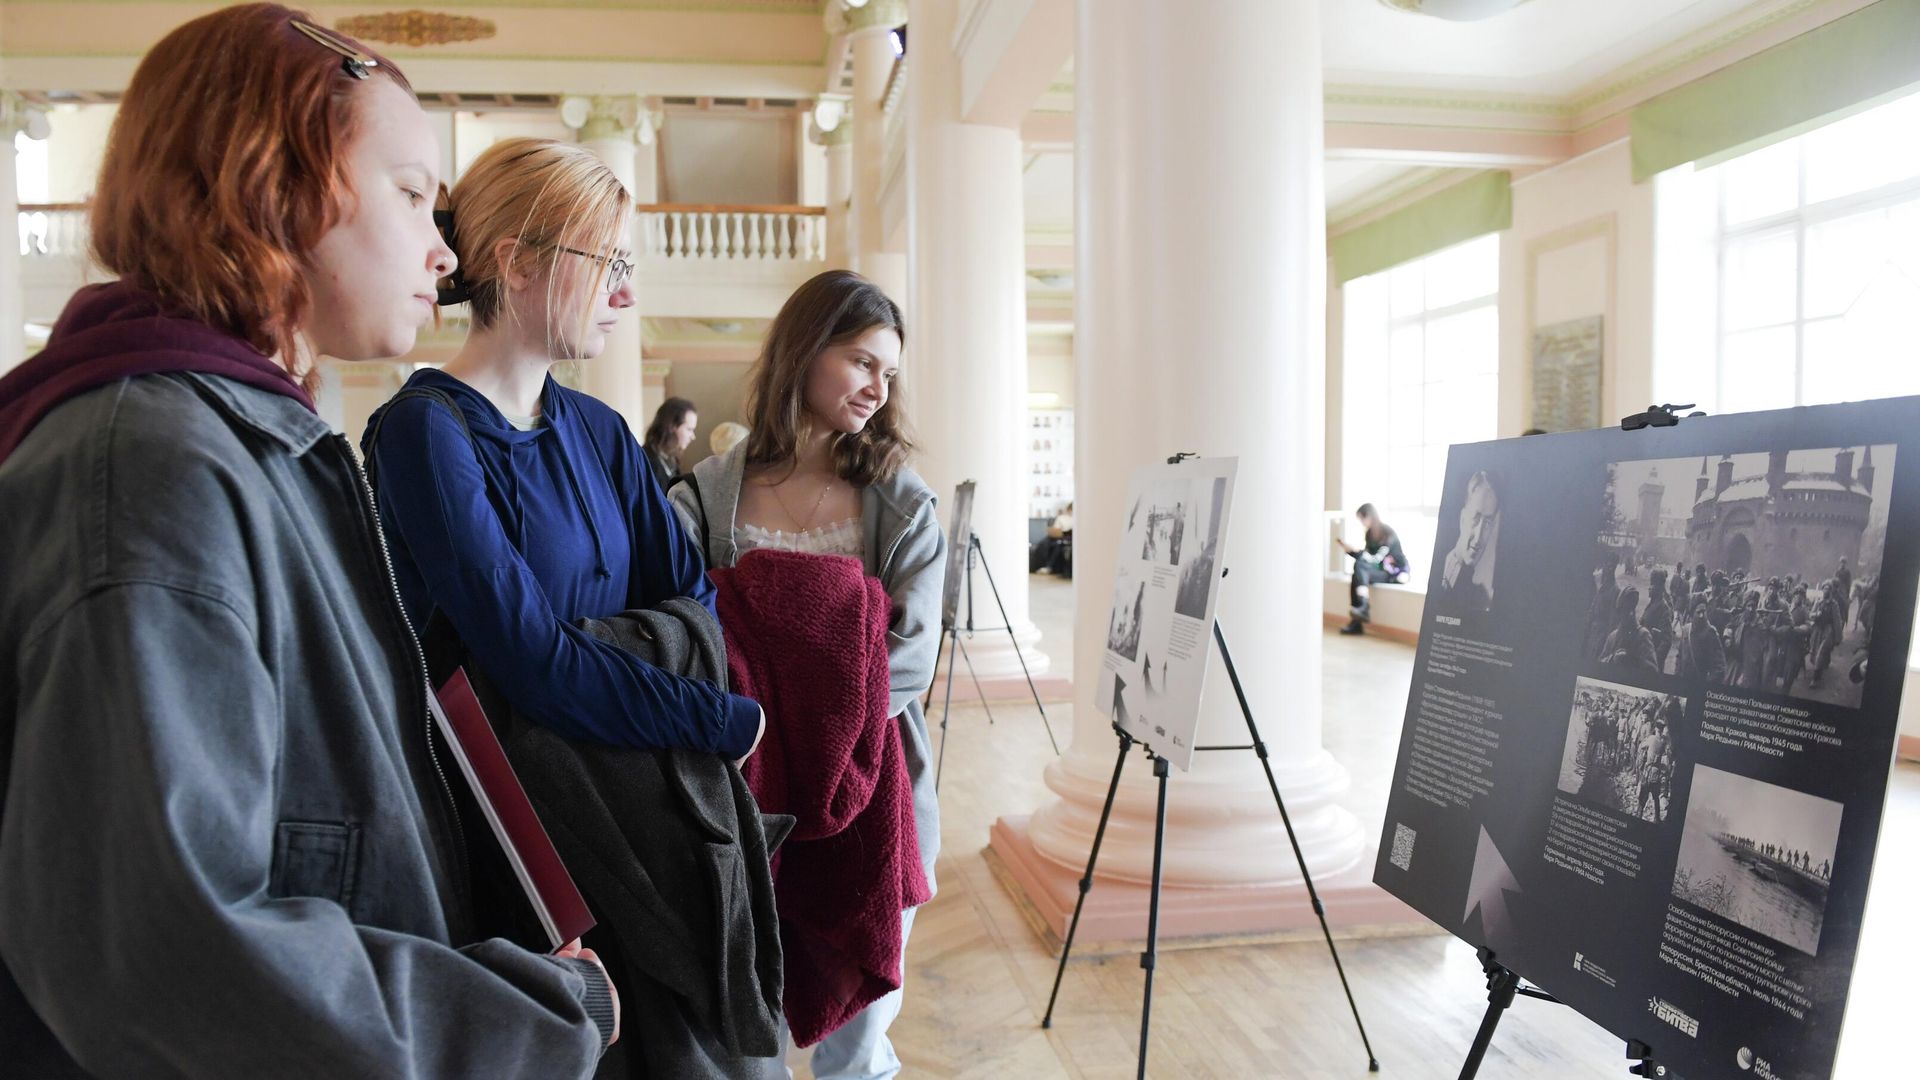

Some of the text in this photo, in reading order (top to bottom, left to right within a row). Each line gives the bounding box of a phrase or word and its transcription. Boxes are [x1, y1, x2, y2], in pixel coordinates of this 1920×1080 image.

[1700, 730, 1714, 740] Марк
[1715, 734, 1740, 746] Редькин
[1744, 740, 1756, 750] РИА
[1757, 744, 1784, 758] Новости
[1659, 951, 1674, 964] Марк
[1674, 958, 1696, 976] Редькин
[1700, 972, 1712, 984] РИА
[1713, 979, 1739, 998] Новости
[1694, 958, 1725, 980] Брестская
[1752, 988, 1770, 1003] июль
[1771, 996, 1786, 1010] 1944
[1756, 1056, 1770, 1072] РИА
